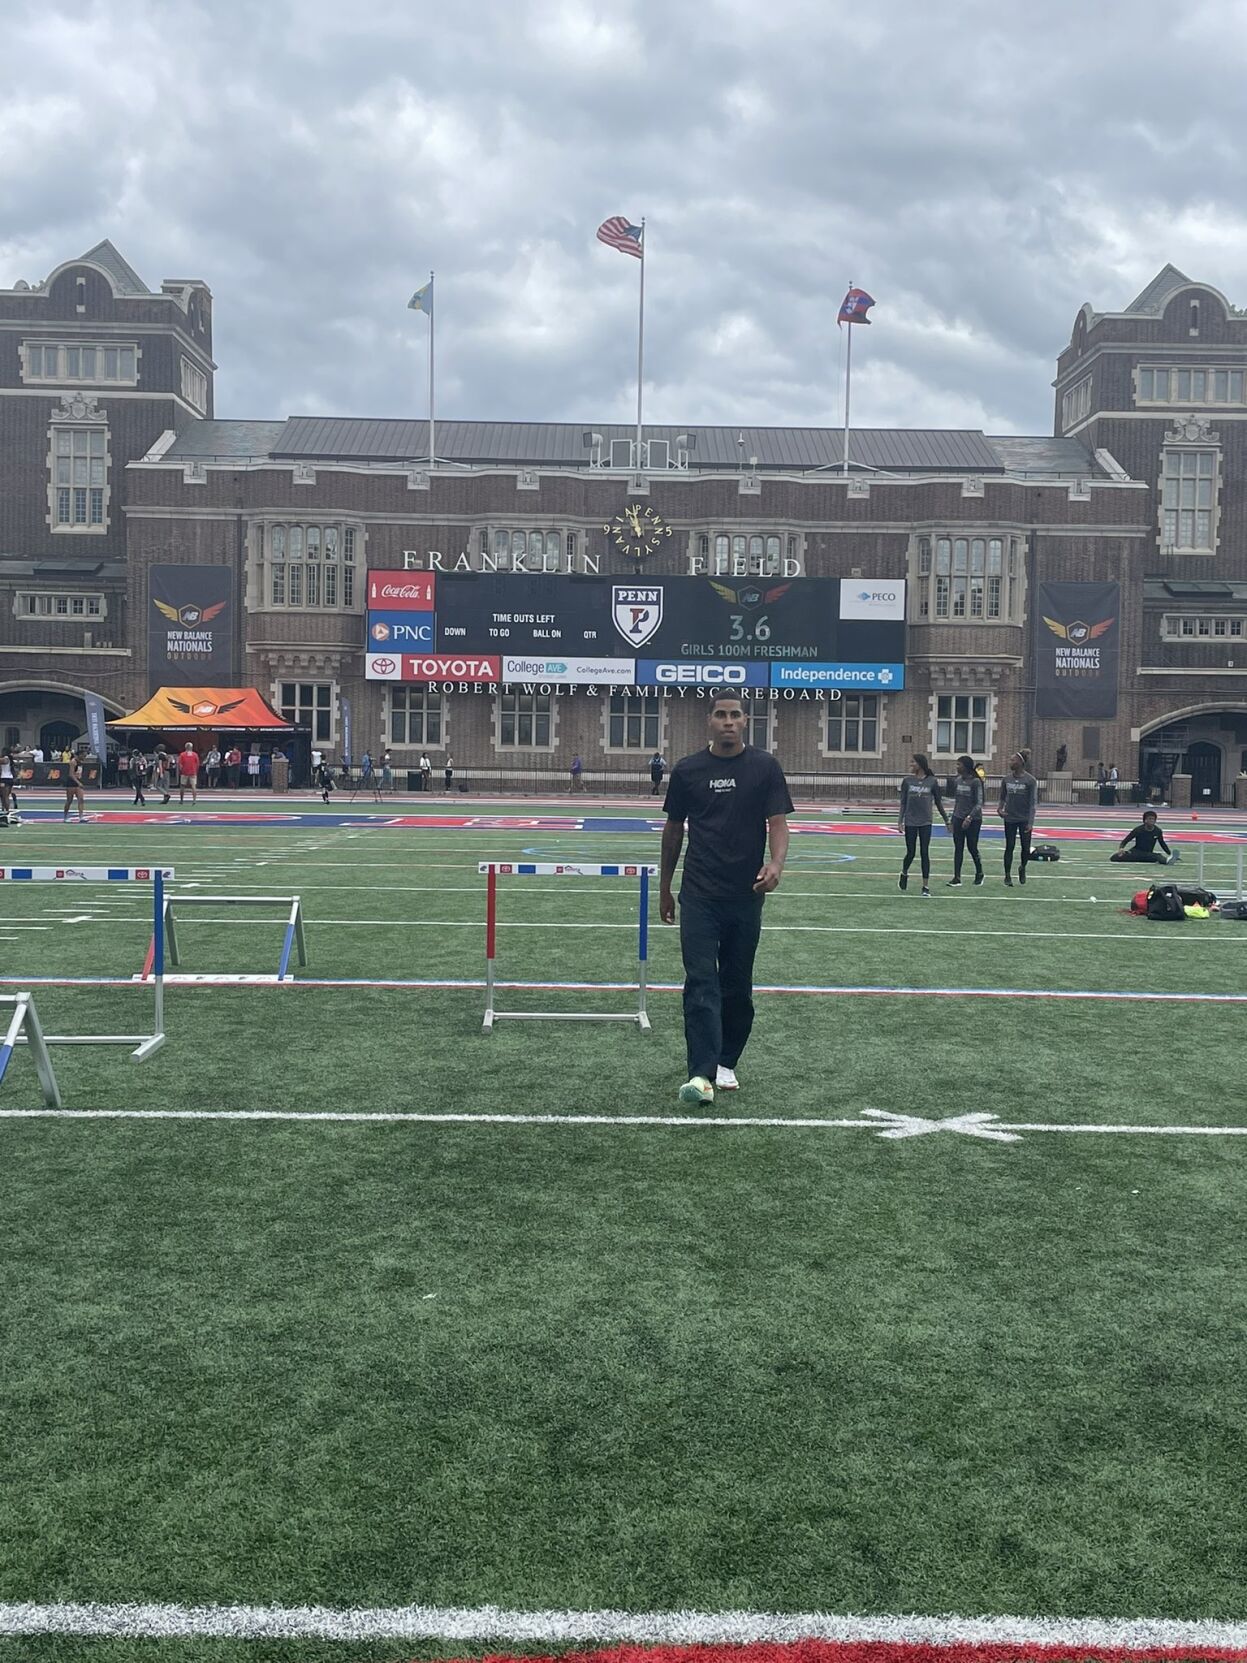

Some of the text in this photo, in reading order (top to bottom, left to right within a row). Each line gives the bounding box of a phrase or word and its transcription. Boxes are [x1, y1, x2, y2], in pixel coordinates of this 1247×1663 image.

[403, 550, 801, 578] FRANKLIN FIELD
[617, 590, 658, 602] PENN
[872, 592, 896, 601] PECO
[492, 613, 556, 624] TIME OUTS LEFT
[392, 625, 432, 641] PNC
[444, 627, 466, 636] DOWN
[489, 628, 510, 638] TO GO
[533, 629, 562, 638] BALL ON
[729, 615, 771, 641] 3.6
[167, 630, 213, 641] NEW BALANCE
[583, 630, 597, 639] QTR
[166, 641, 213, 652] NATIONALS
[681, 643, 818, 658] GIRLS 100M FRESHMAN
[1055, 647, 1100, 658] NEW BALANCE
[409, 658, 494, 678] TOYOTA
[507, 660, 545, 676] College
[1055, 657, 1100, 669] NATIONALS
[576, 665, 632, 676] CollegeAve.com
[655, 664, 746, 684] GEICO
[780, 667, 876, 682] Independence
[427, 680, 512, 695] ROBERT
[523, 683, 579, 696] WOLF
[586, 684, 599, 697] &
[609, 684, 689, 699] FAMILY
[709, 778, 736, 789] HOKA
